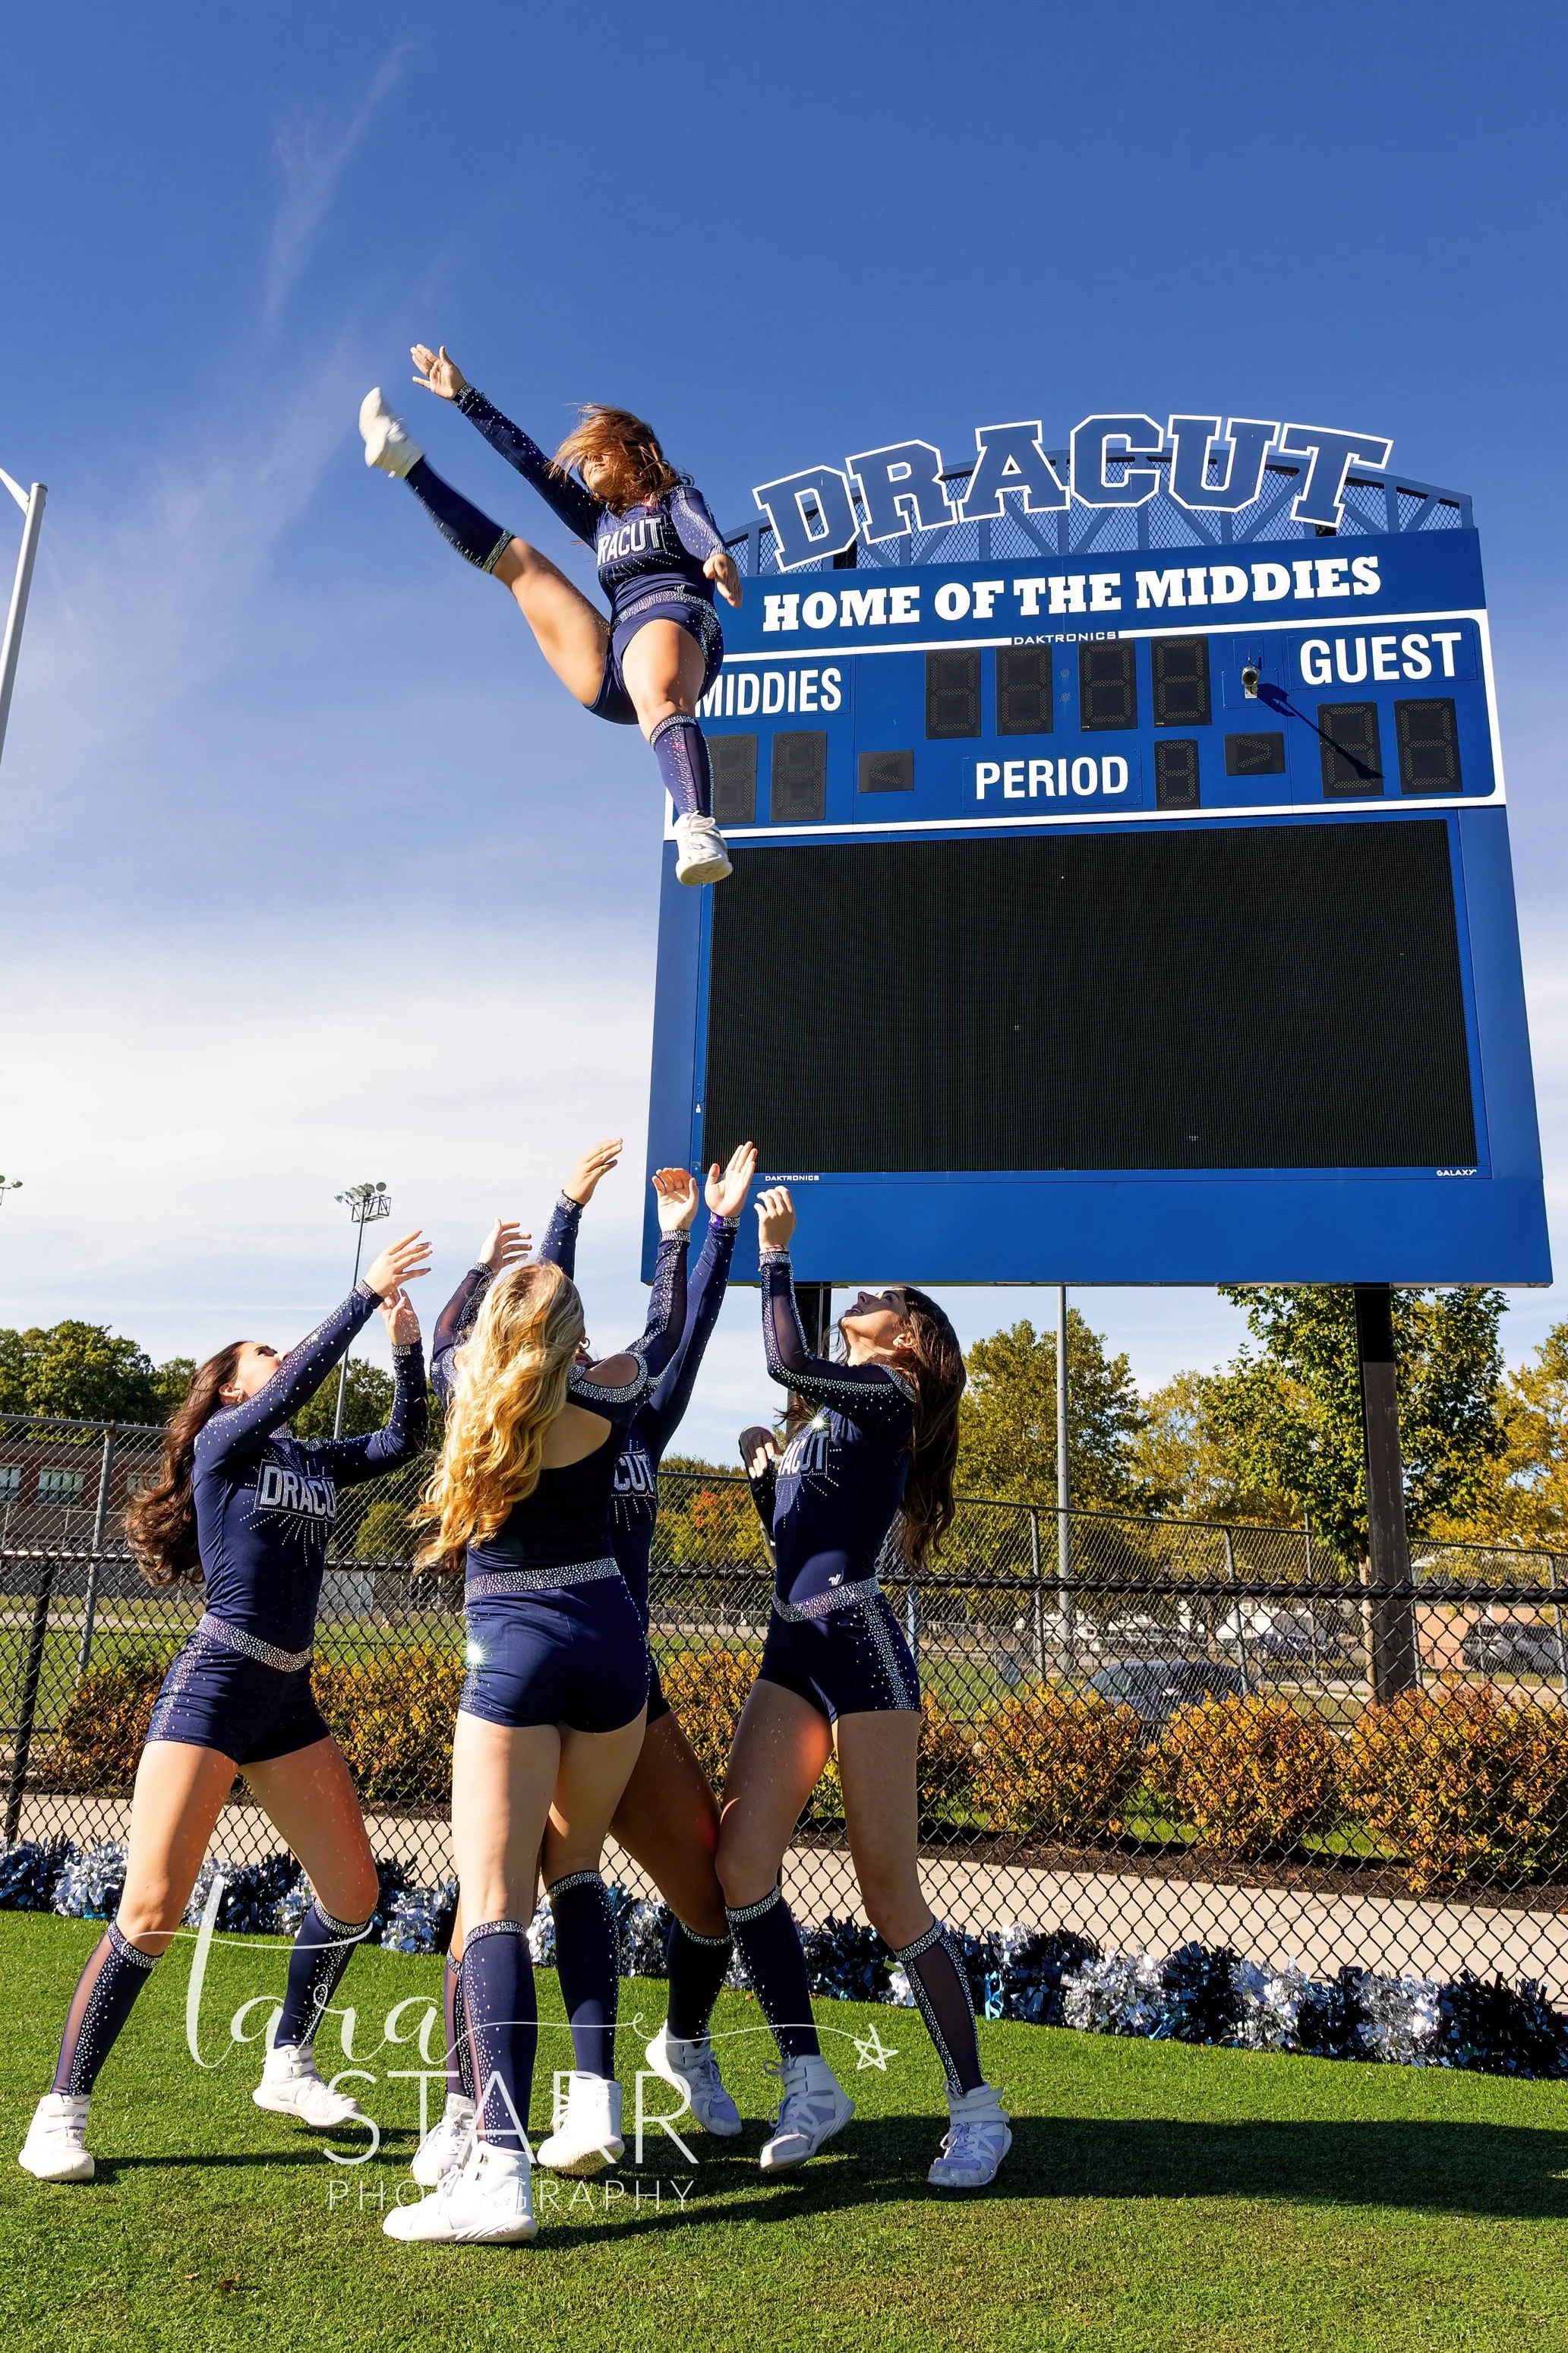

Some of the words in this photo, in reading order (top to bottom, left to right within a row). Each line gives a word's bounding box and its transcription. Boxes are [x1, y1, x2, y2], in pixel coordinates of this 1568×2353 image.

[752, 414, 1394, 572] DRACUT
[762, 586, 921, 632] HOME
[934, 580, 1005, 621] OF
[1013, 573, 1122, 617] THE
[1135, 555, 1382, 609] MIDDIES
[1014, 631, 1117, 646] DAKTRONICS
[1299, 631, 1462, 686] GUEST
[695, 667, 842, 718] MIDDIES
[976, 756, 1128, 800] PERIOD
